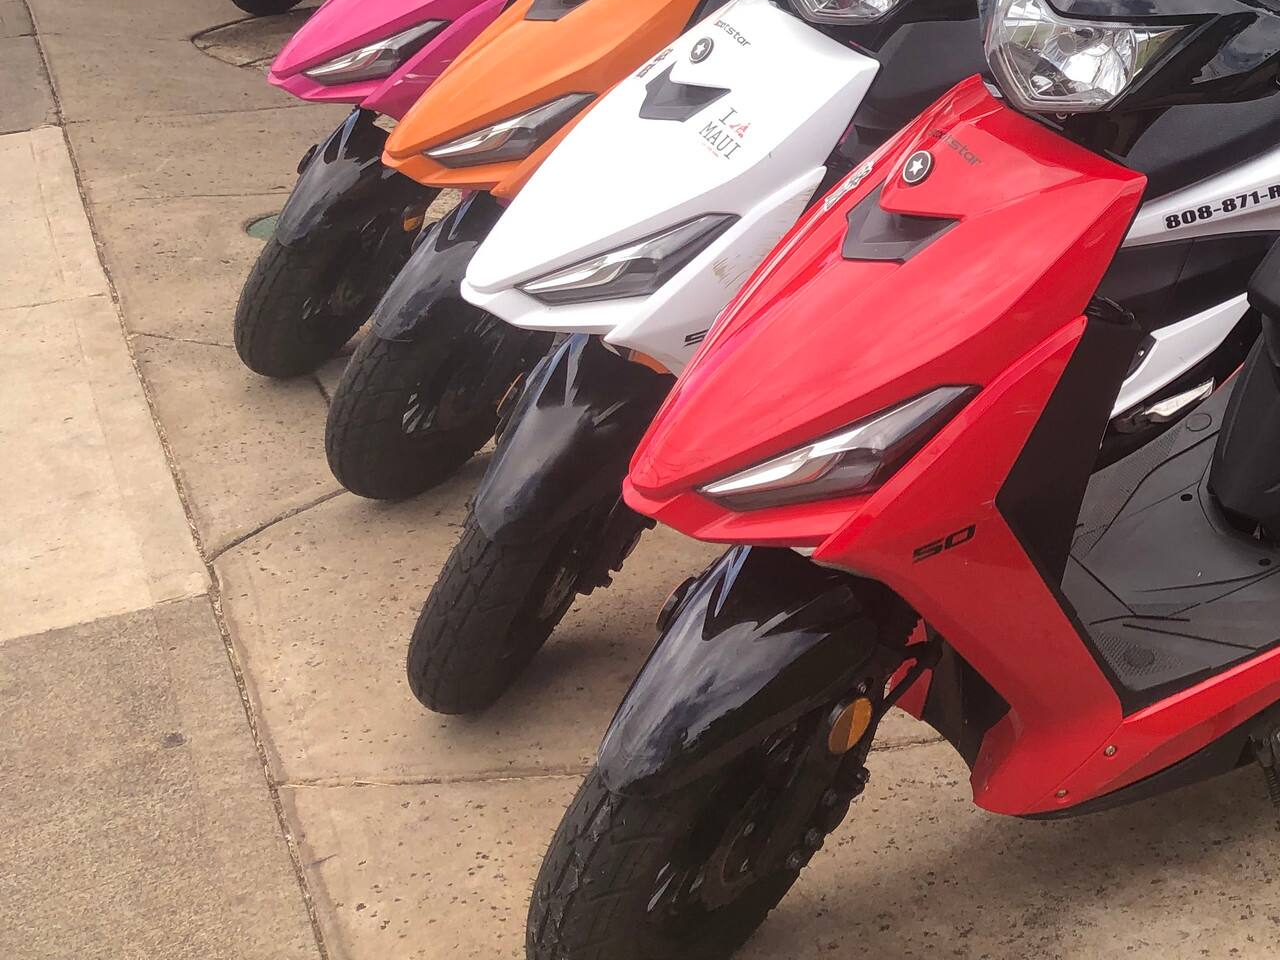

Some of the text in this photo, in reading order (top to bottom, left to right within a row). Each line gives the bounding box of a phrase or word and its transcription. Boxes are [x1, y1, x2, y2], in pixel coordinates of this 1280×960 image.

[718, 107, 738, 125] I
[699, 121, 741, 160] MAUI
[683, 328, 710, 349] 5
[912, 524, 977, 564] 50
